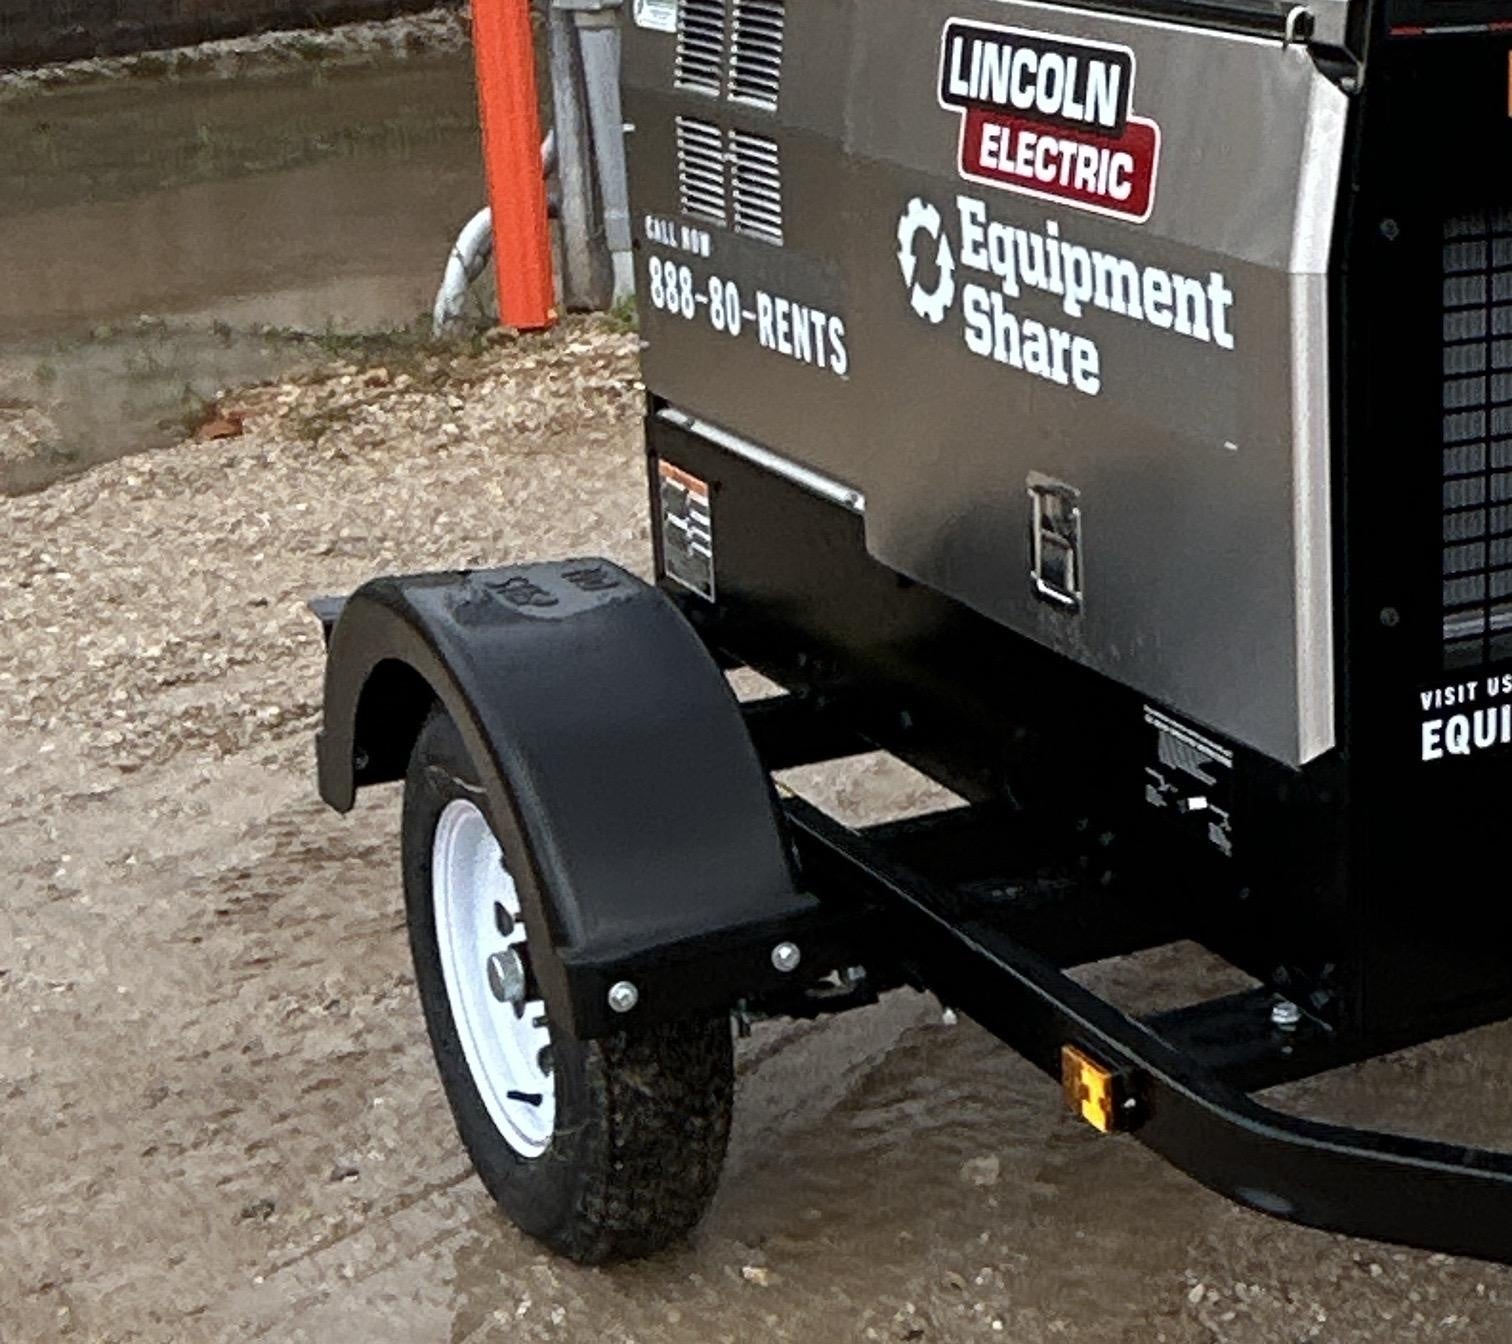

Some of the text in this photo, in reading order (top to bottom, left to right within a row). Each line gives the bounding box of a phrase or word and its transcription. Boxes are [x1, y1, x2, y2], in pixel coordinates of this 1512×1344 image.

[949, 35, 1121, 128] LINCOLN
[978, 123, 1134, 201] ELECTRIC
[645, 214, 679, 248] CALL
[956, 194, 1235, 350] Equipment
[648, 255, 848, 376] 888-80-RENTS
[962, 283, 1101, 397] Share
[1420, 680, 1478, 711] VISIT
